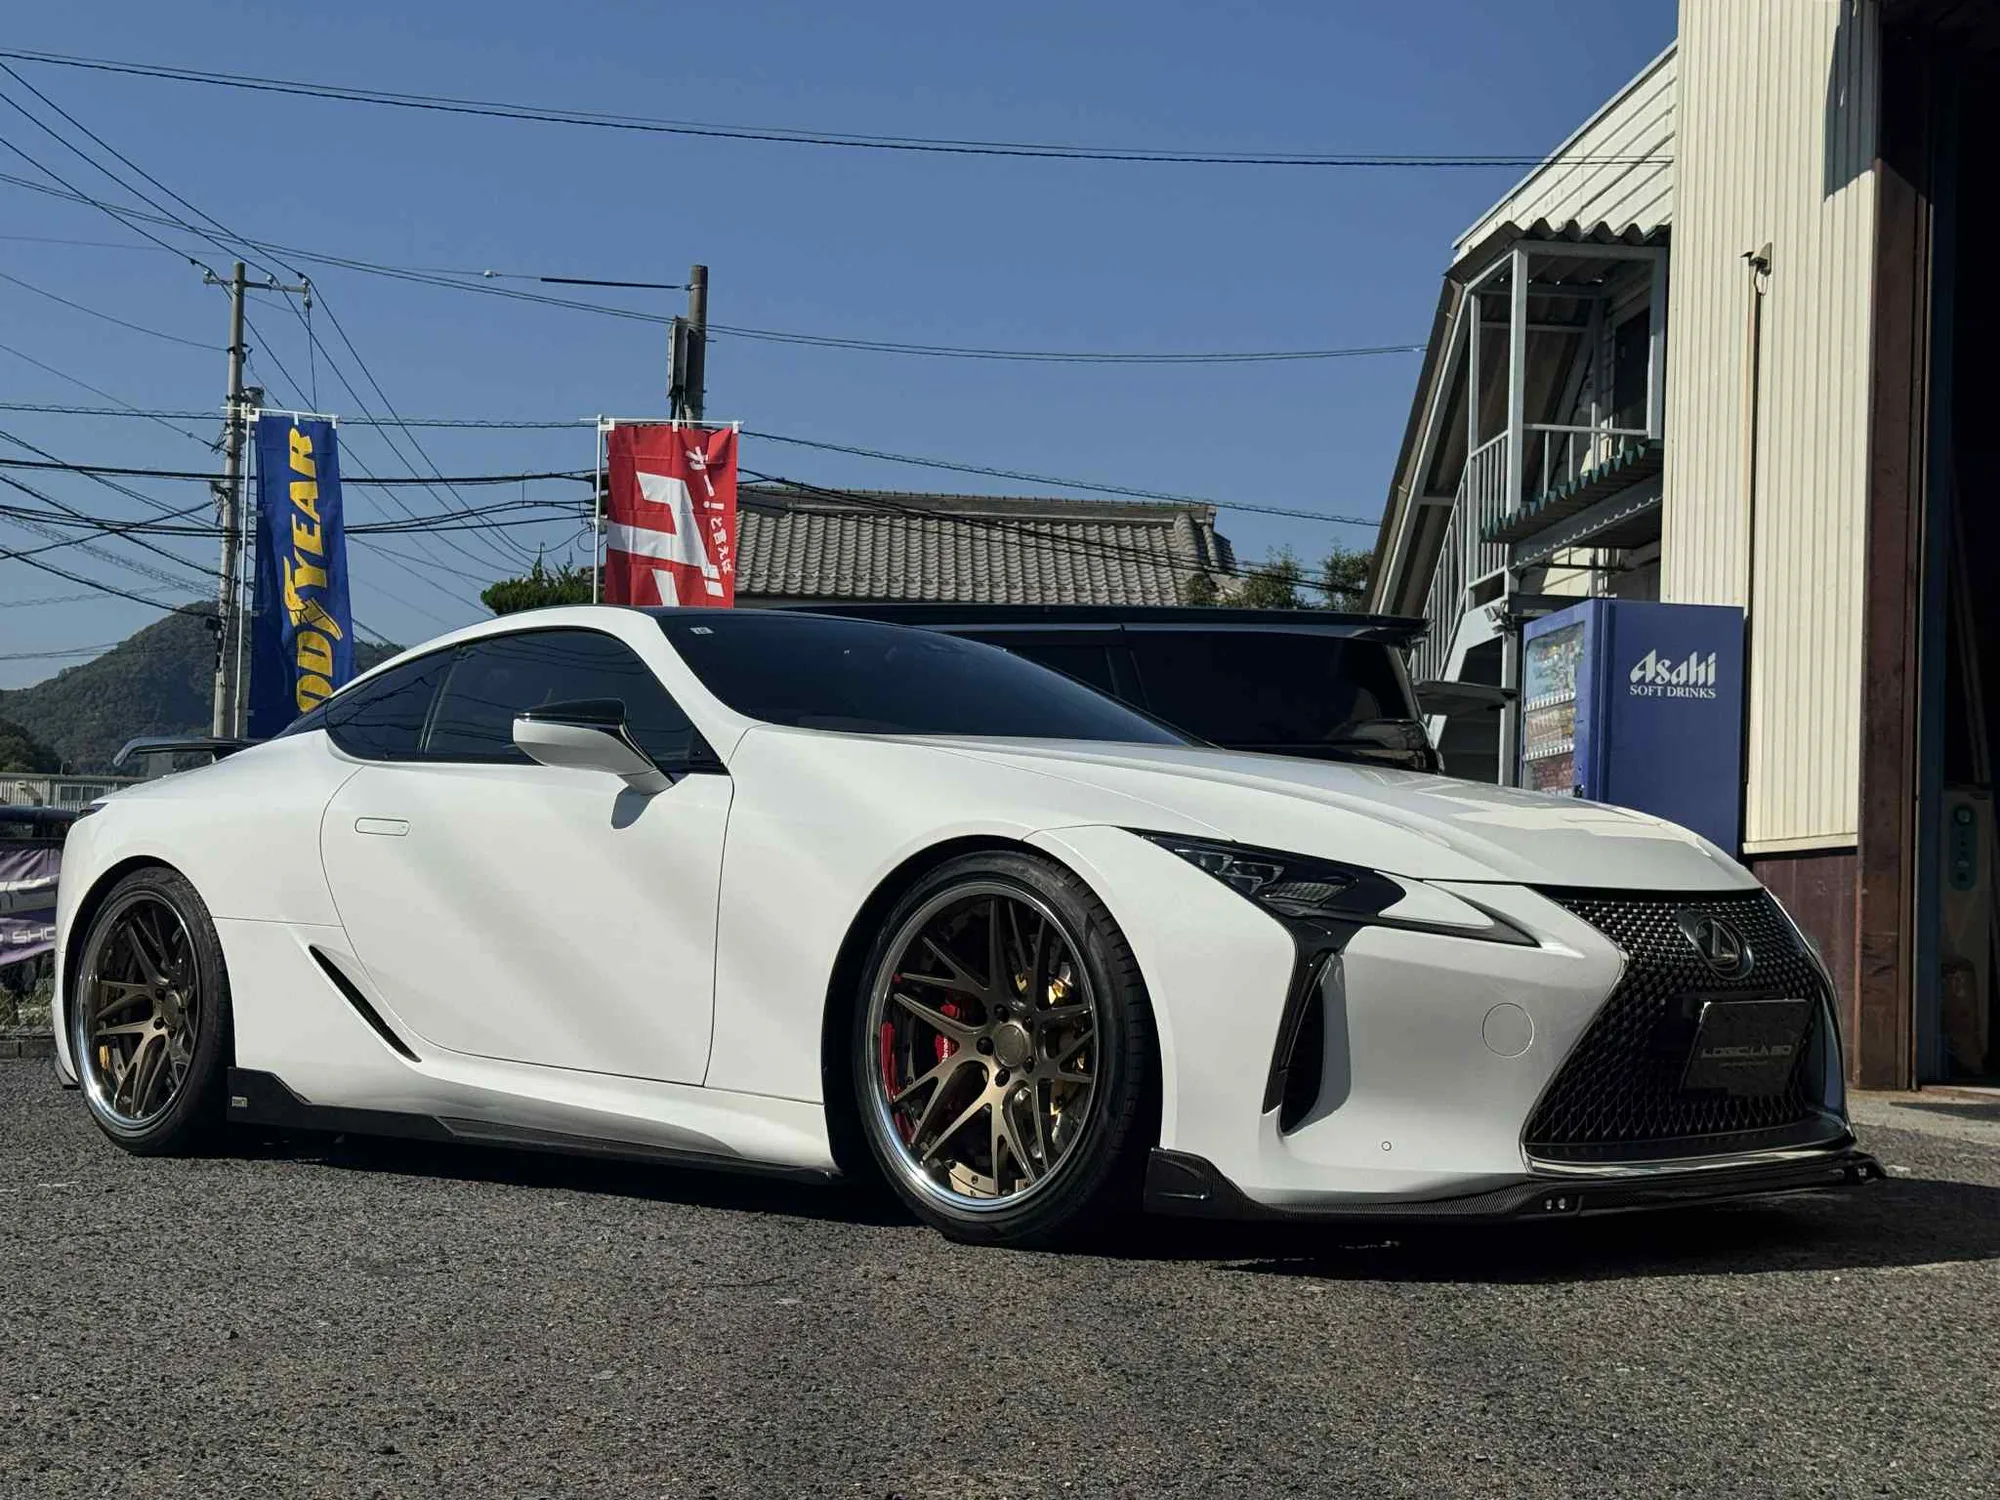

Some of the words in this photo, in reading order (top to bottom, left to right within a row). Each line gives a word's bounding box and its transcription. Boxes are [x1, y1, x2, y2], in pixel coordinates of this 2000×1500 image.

[1630, 648, 1716, 686] Asahi
[1629, 684, 1664, 696] SOFT
[1666, 685, 1716, 698] DRINKS
